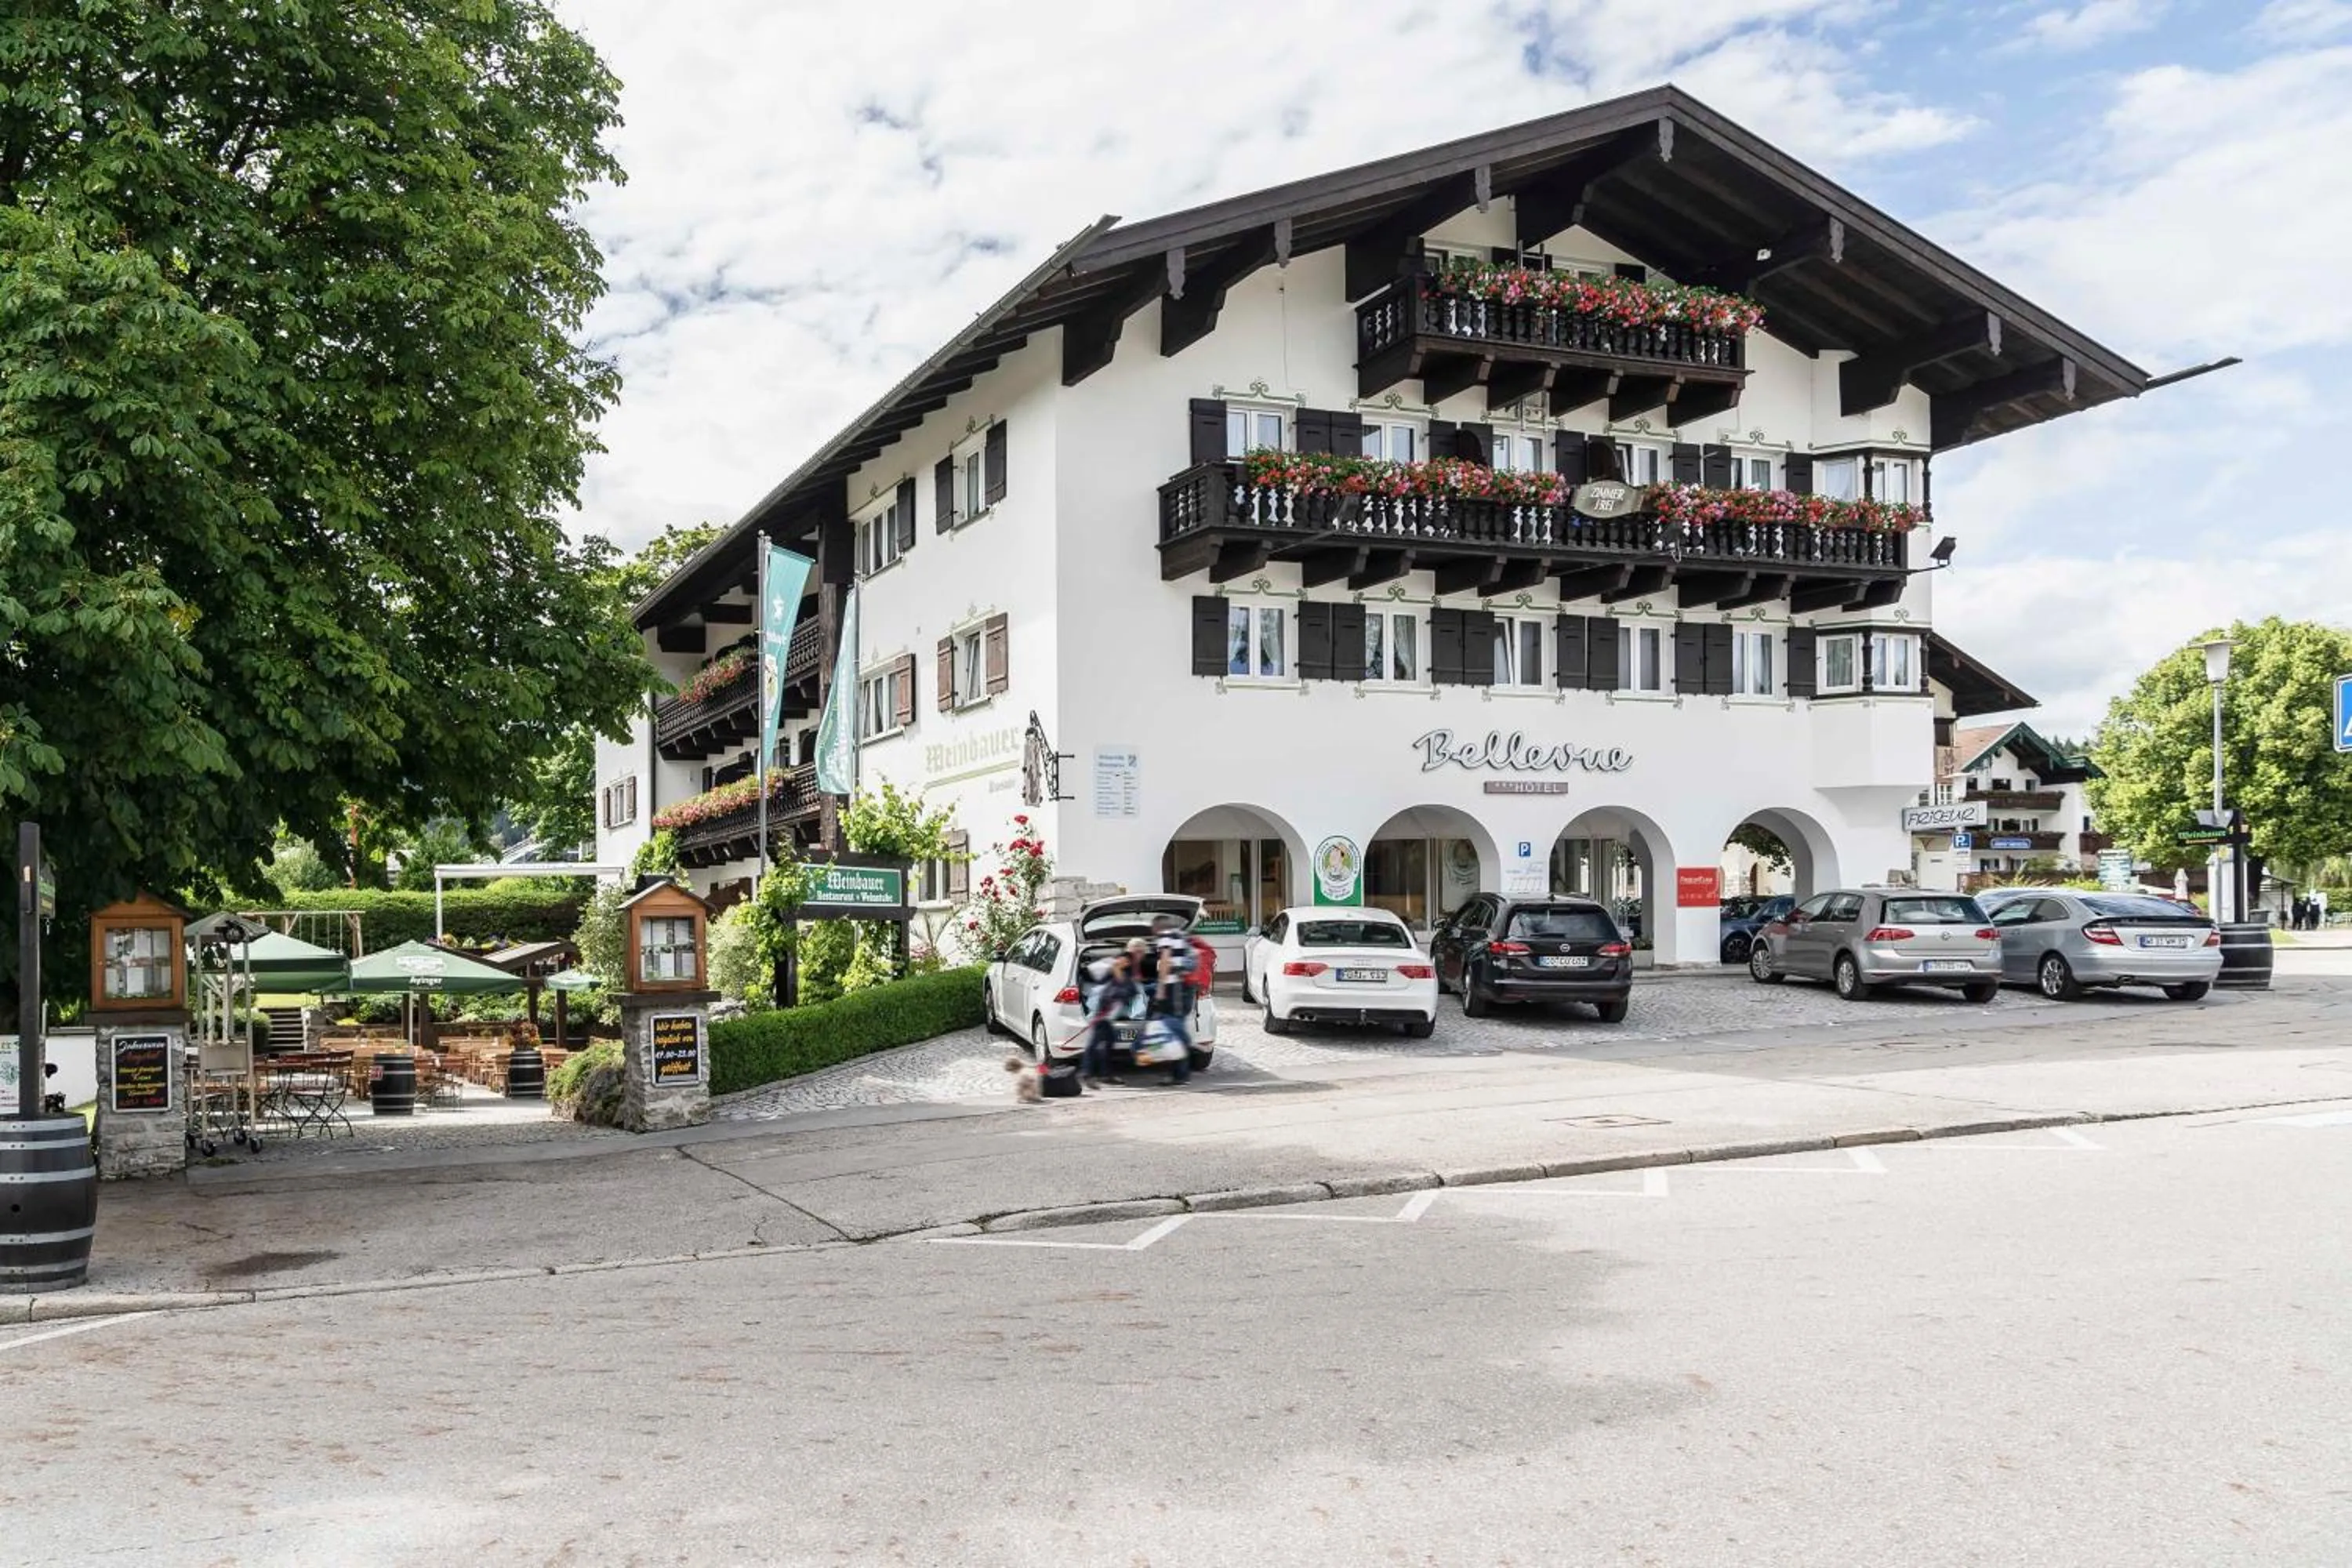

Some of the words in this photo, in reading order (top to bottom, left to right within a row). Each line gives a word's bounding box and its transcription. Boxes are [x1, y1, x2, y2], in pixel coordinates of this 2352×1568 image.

[1412, 728, 1633, 772] Bellevue
[1515, 781, 1560, 793] HOTEL
[1520, 842, 1530, 856] P
[826, 871, 885, 891] Weinbauer
